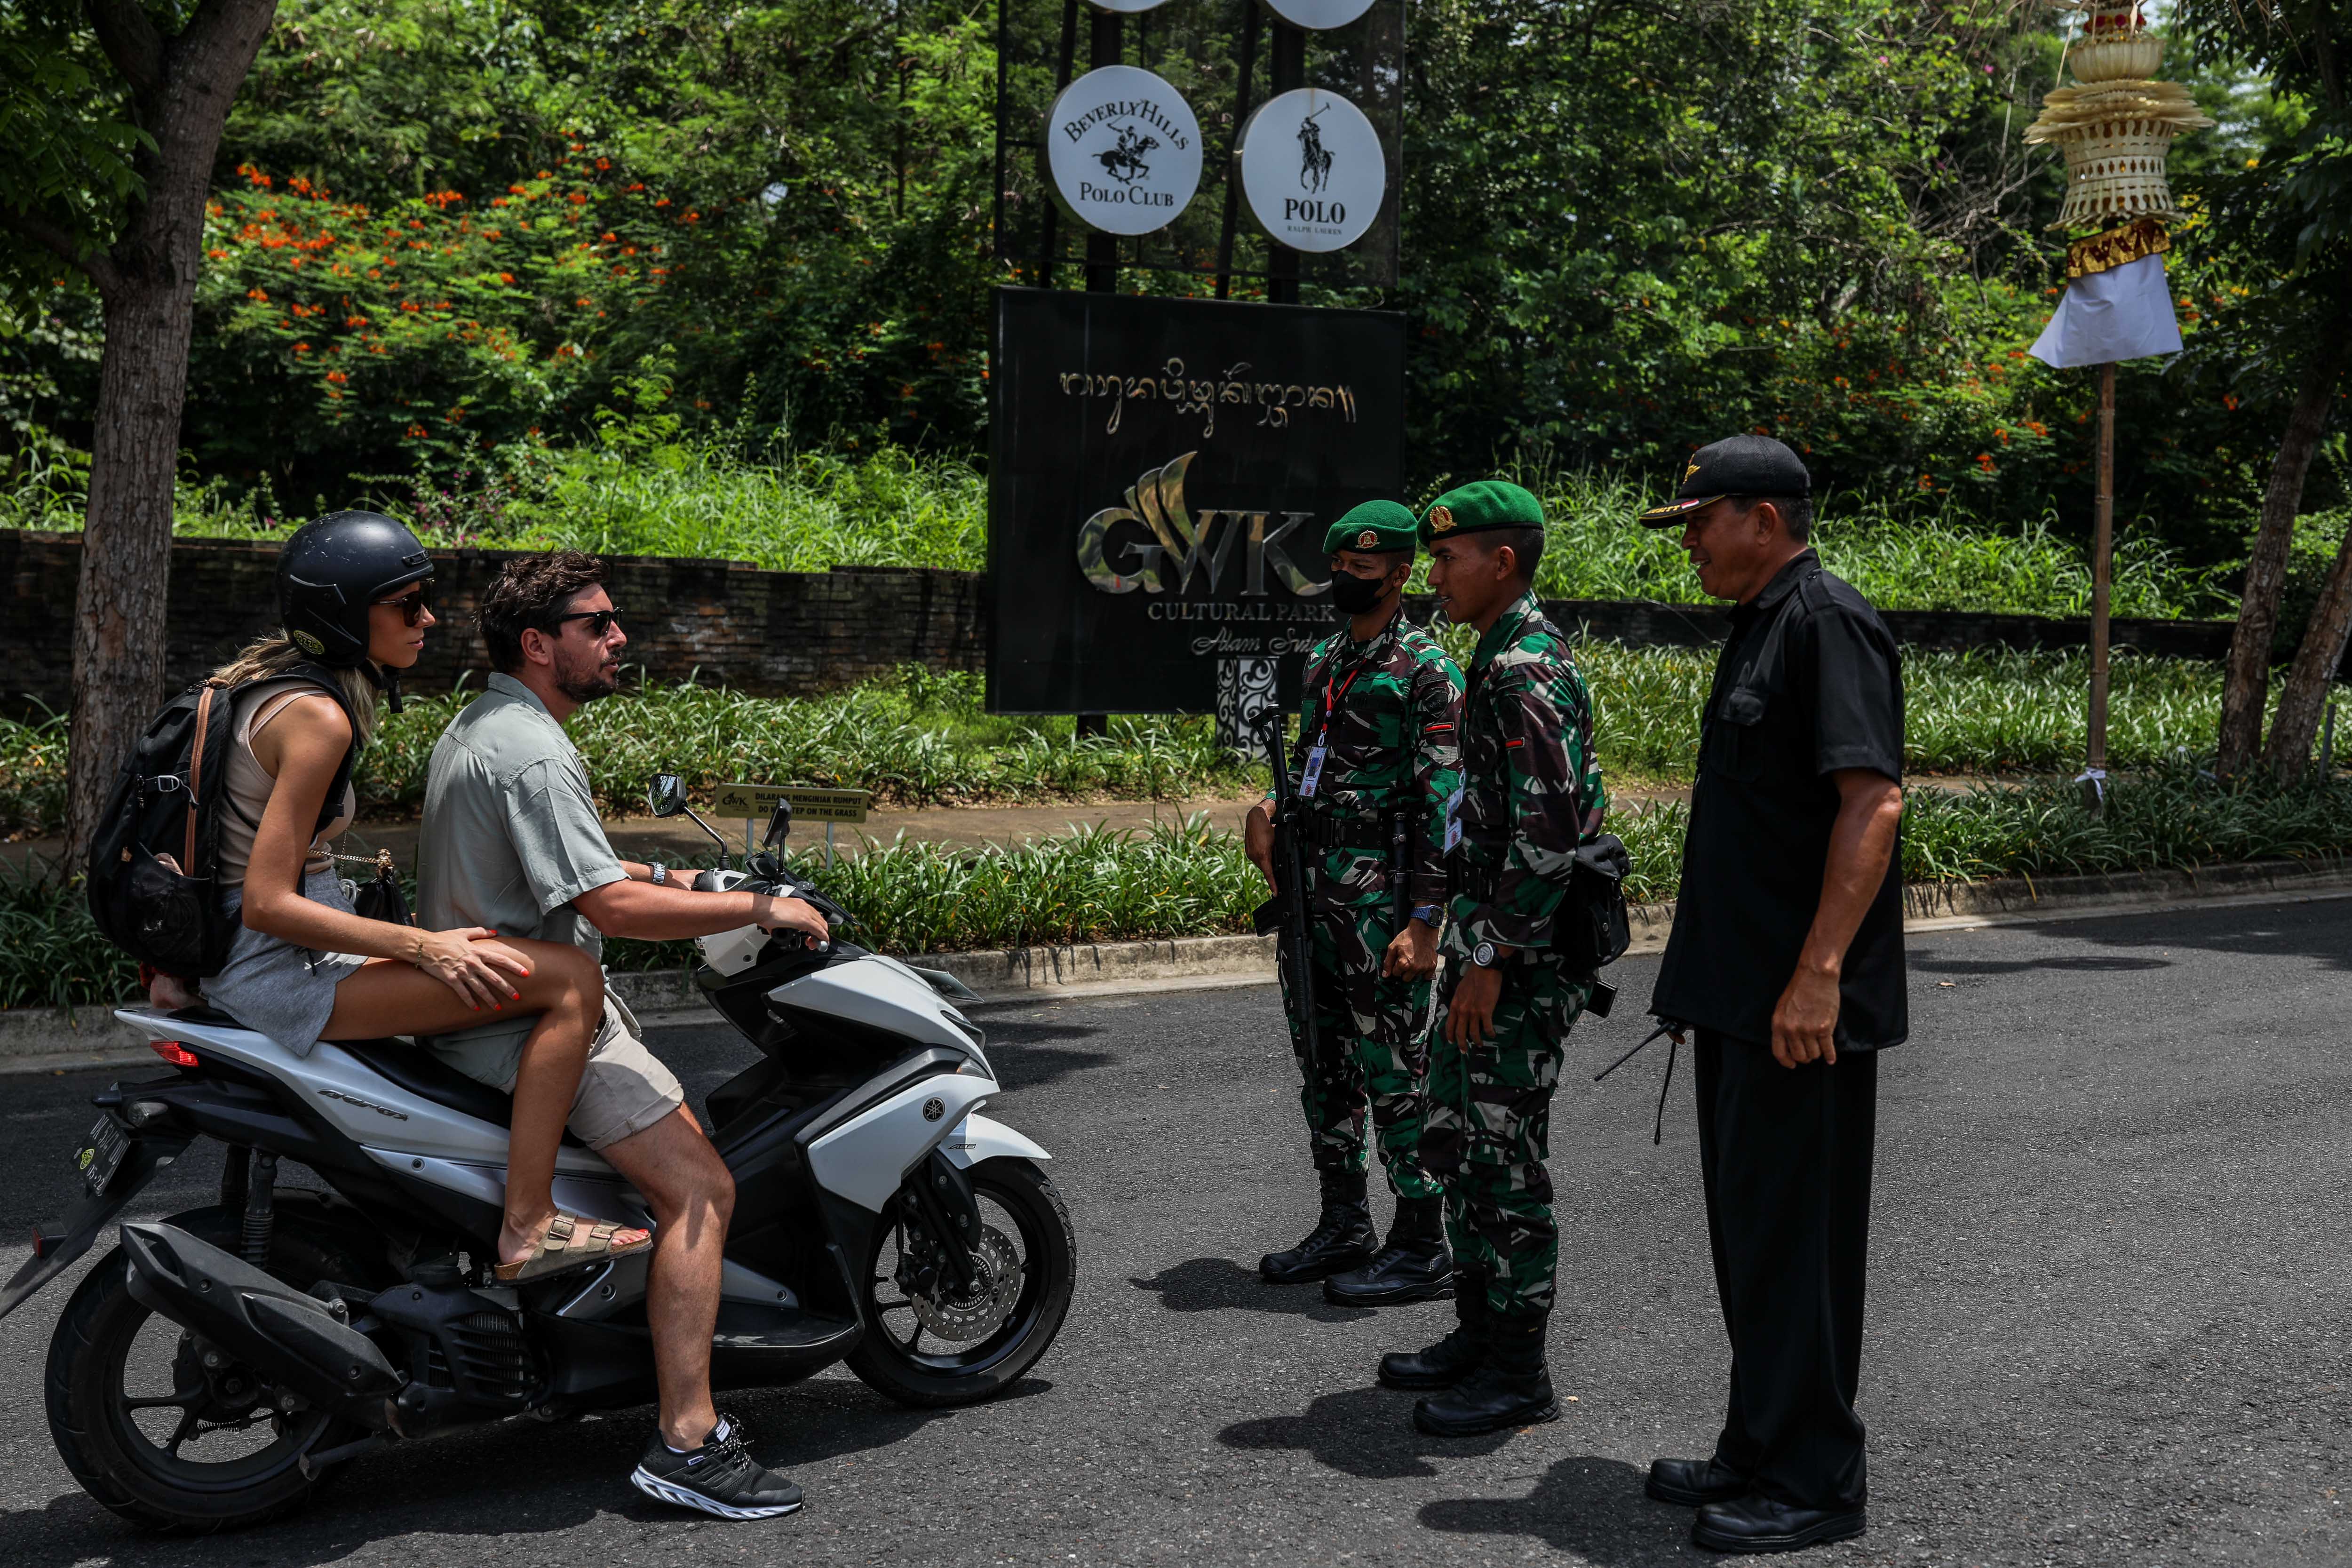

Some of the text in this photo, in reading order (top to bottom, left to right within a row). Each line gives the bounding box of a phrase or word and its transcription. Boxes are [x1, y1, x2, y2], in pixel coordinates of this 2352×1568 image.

[1064, 99, 1190, 151] BEVERLY HILLS
[1080, 182, 1174, 207] POLO CLUB
[1284, 198, 1346, 225] POLO
[1077, 451, 1334, 597] GWK
[1148, 603, 1336, 622] CULTURAL PARK
[1191, 627, 1261, 656] Alam
[723, 792, 748, 805] GWK
[755, 793, 790, 802] DILARANG
[833, 796, 862, 805] RUMPUT
[807, 808, 817, 816] ON
[819, 809, 833, 817] THE
[834, 809, 858, 818] GRASS
[90, 1114, 109, 1140] DK
